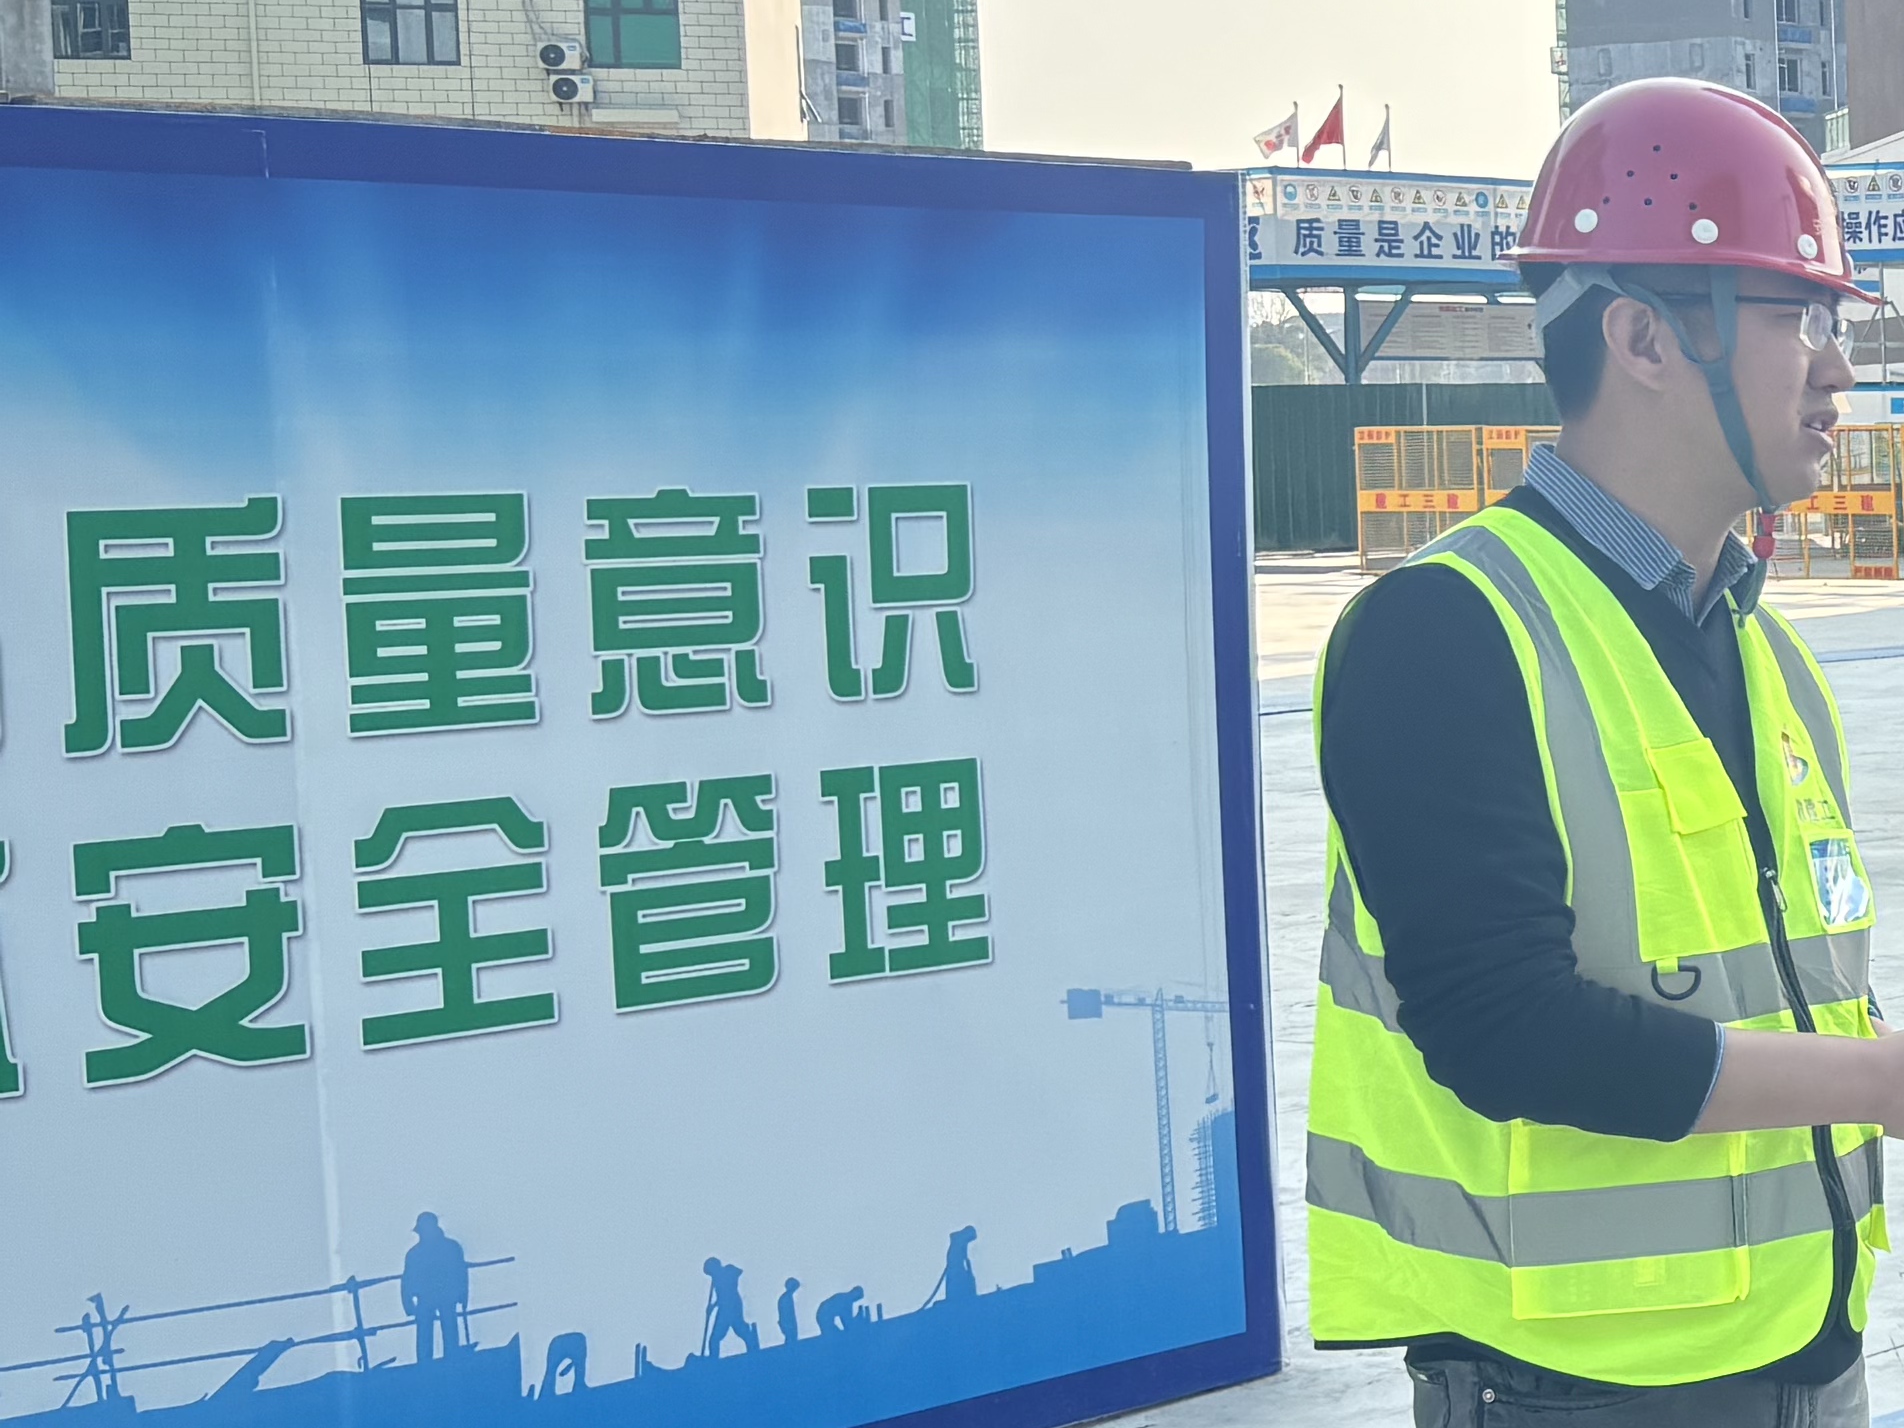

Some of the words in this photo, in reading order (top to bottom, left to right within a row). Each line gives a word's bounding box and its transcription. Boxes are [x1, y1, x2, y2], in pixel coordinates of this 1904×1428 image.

[1293, 216, 1517, 262] 质量是企业的
[1374, 492, 1460, 510] 建工三建
[1786, 495, 1874, 512] 工三建
[61, 481, 981, 759] 质量意识
[0, 758, 994, 1099] 安全管理
